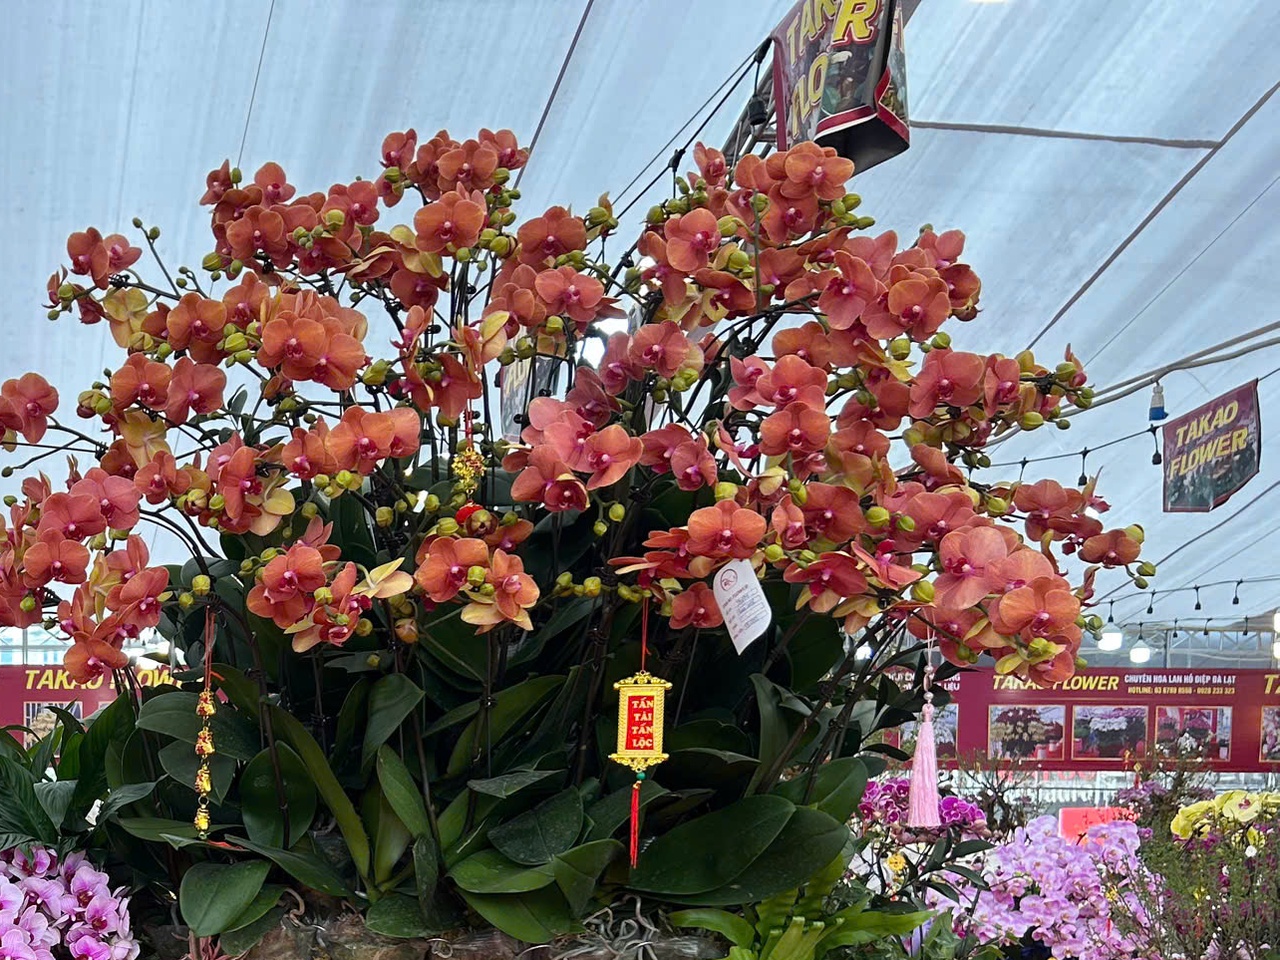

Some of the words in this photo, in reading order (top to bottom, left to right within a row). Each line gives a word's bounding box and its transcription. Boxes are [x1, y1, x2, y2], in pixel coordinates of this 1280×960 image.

[1176, 401, 1239, 448] TAKAO
[1169, 427, 1248, 480] FLOWER
[632, 737, 653, 749] LỘC
